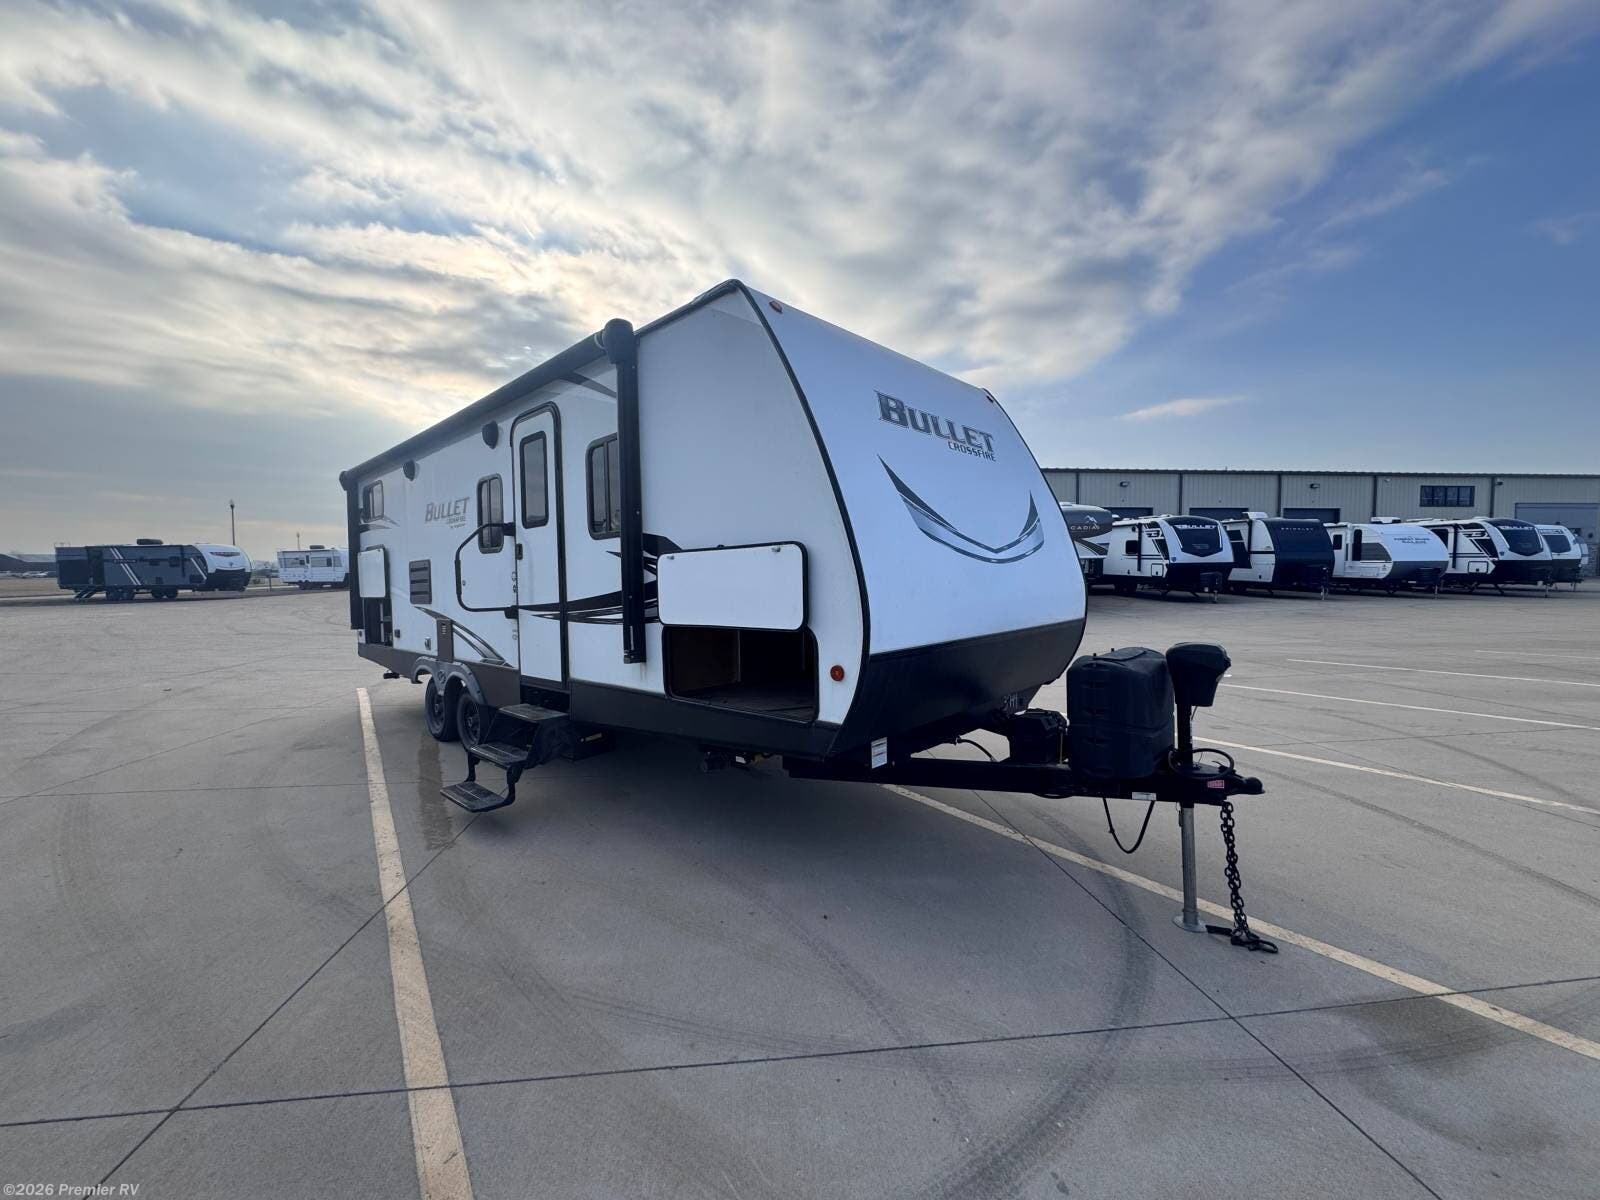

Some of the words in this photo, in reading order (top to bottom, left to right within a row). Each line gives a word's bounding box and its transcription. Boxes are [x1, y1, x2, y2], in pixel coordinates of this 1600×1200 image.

[873, 389, 994, 453] BULLET
[947, 440, 997, 462] CROSSFIRE
[425, 497, 470, 523] BULLET
